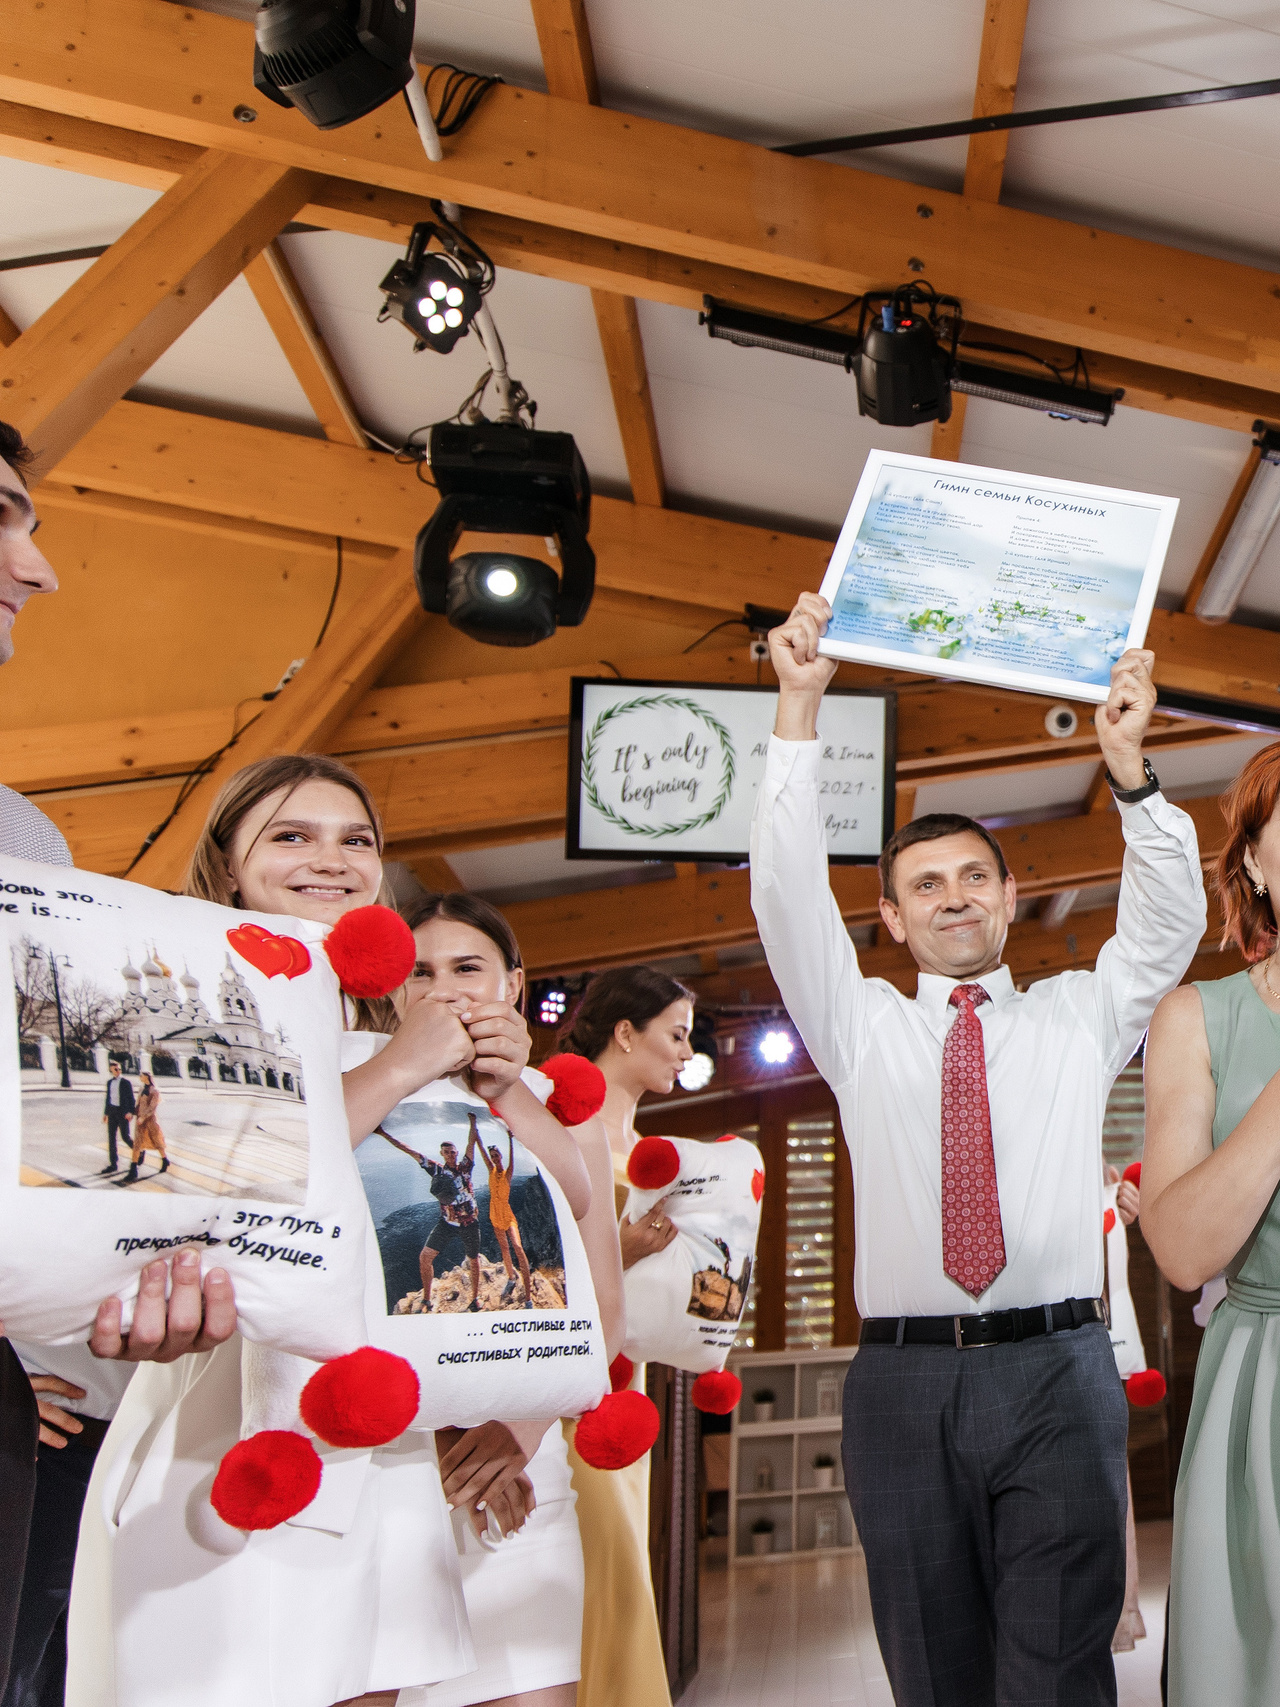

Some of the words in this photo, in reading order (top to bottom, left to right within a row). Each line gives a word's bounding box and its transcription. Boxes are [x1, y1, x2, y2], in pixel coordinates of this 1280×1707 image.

[933, 479, 970, 494] Гимн
[974, 488, 1021, 503] семьи
[1024, 495, 1107, 517] Косухиных
[661, 732, 711, 770] only
[839, 746, 876, 760] Irina
[621, 774, 701, 810] begining
[819, 781, 863, 795] 2021
[823, 813, 859, 837] ly22
[233, 1211, 273, 1226] это
[280, 1216, 324, 1235] путь
[331, 1225, 341, 1239] в
[228, 1232, 327, 1271] будущее.
[491, 1320, 566, 1335] счастливые
[569, 1319, 593, 1333] дети
[437, 1347, 523, 1365] счастливых
[526, 1340, 594, 1363] родителей.
